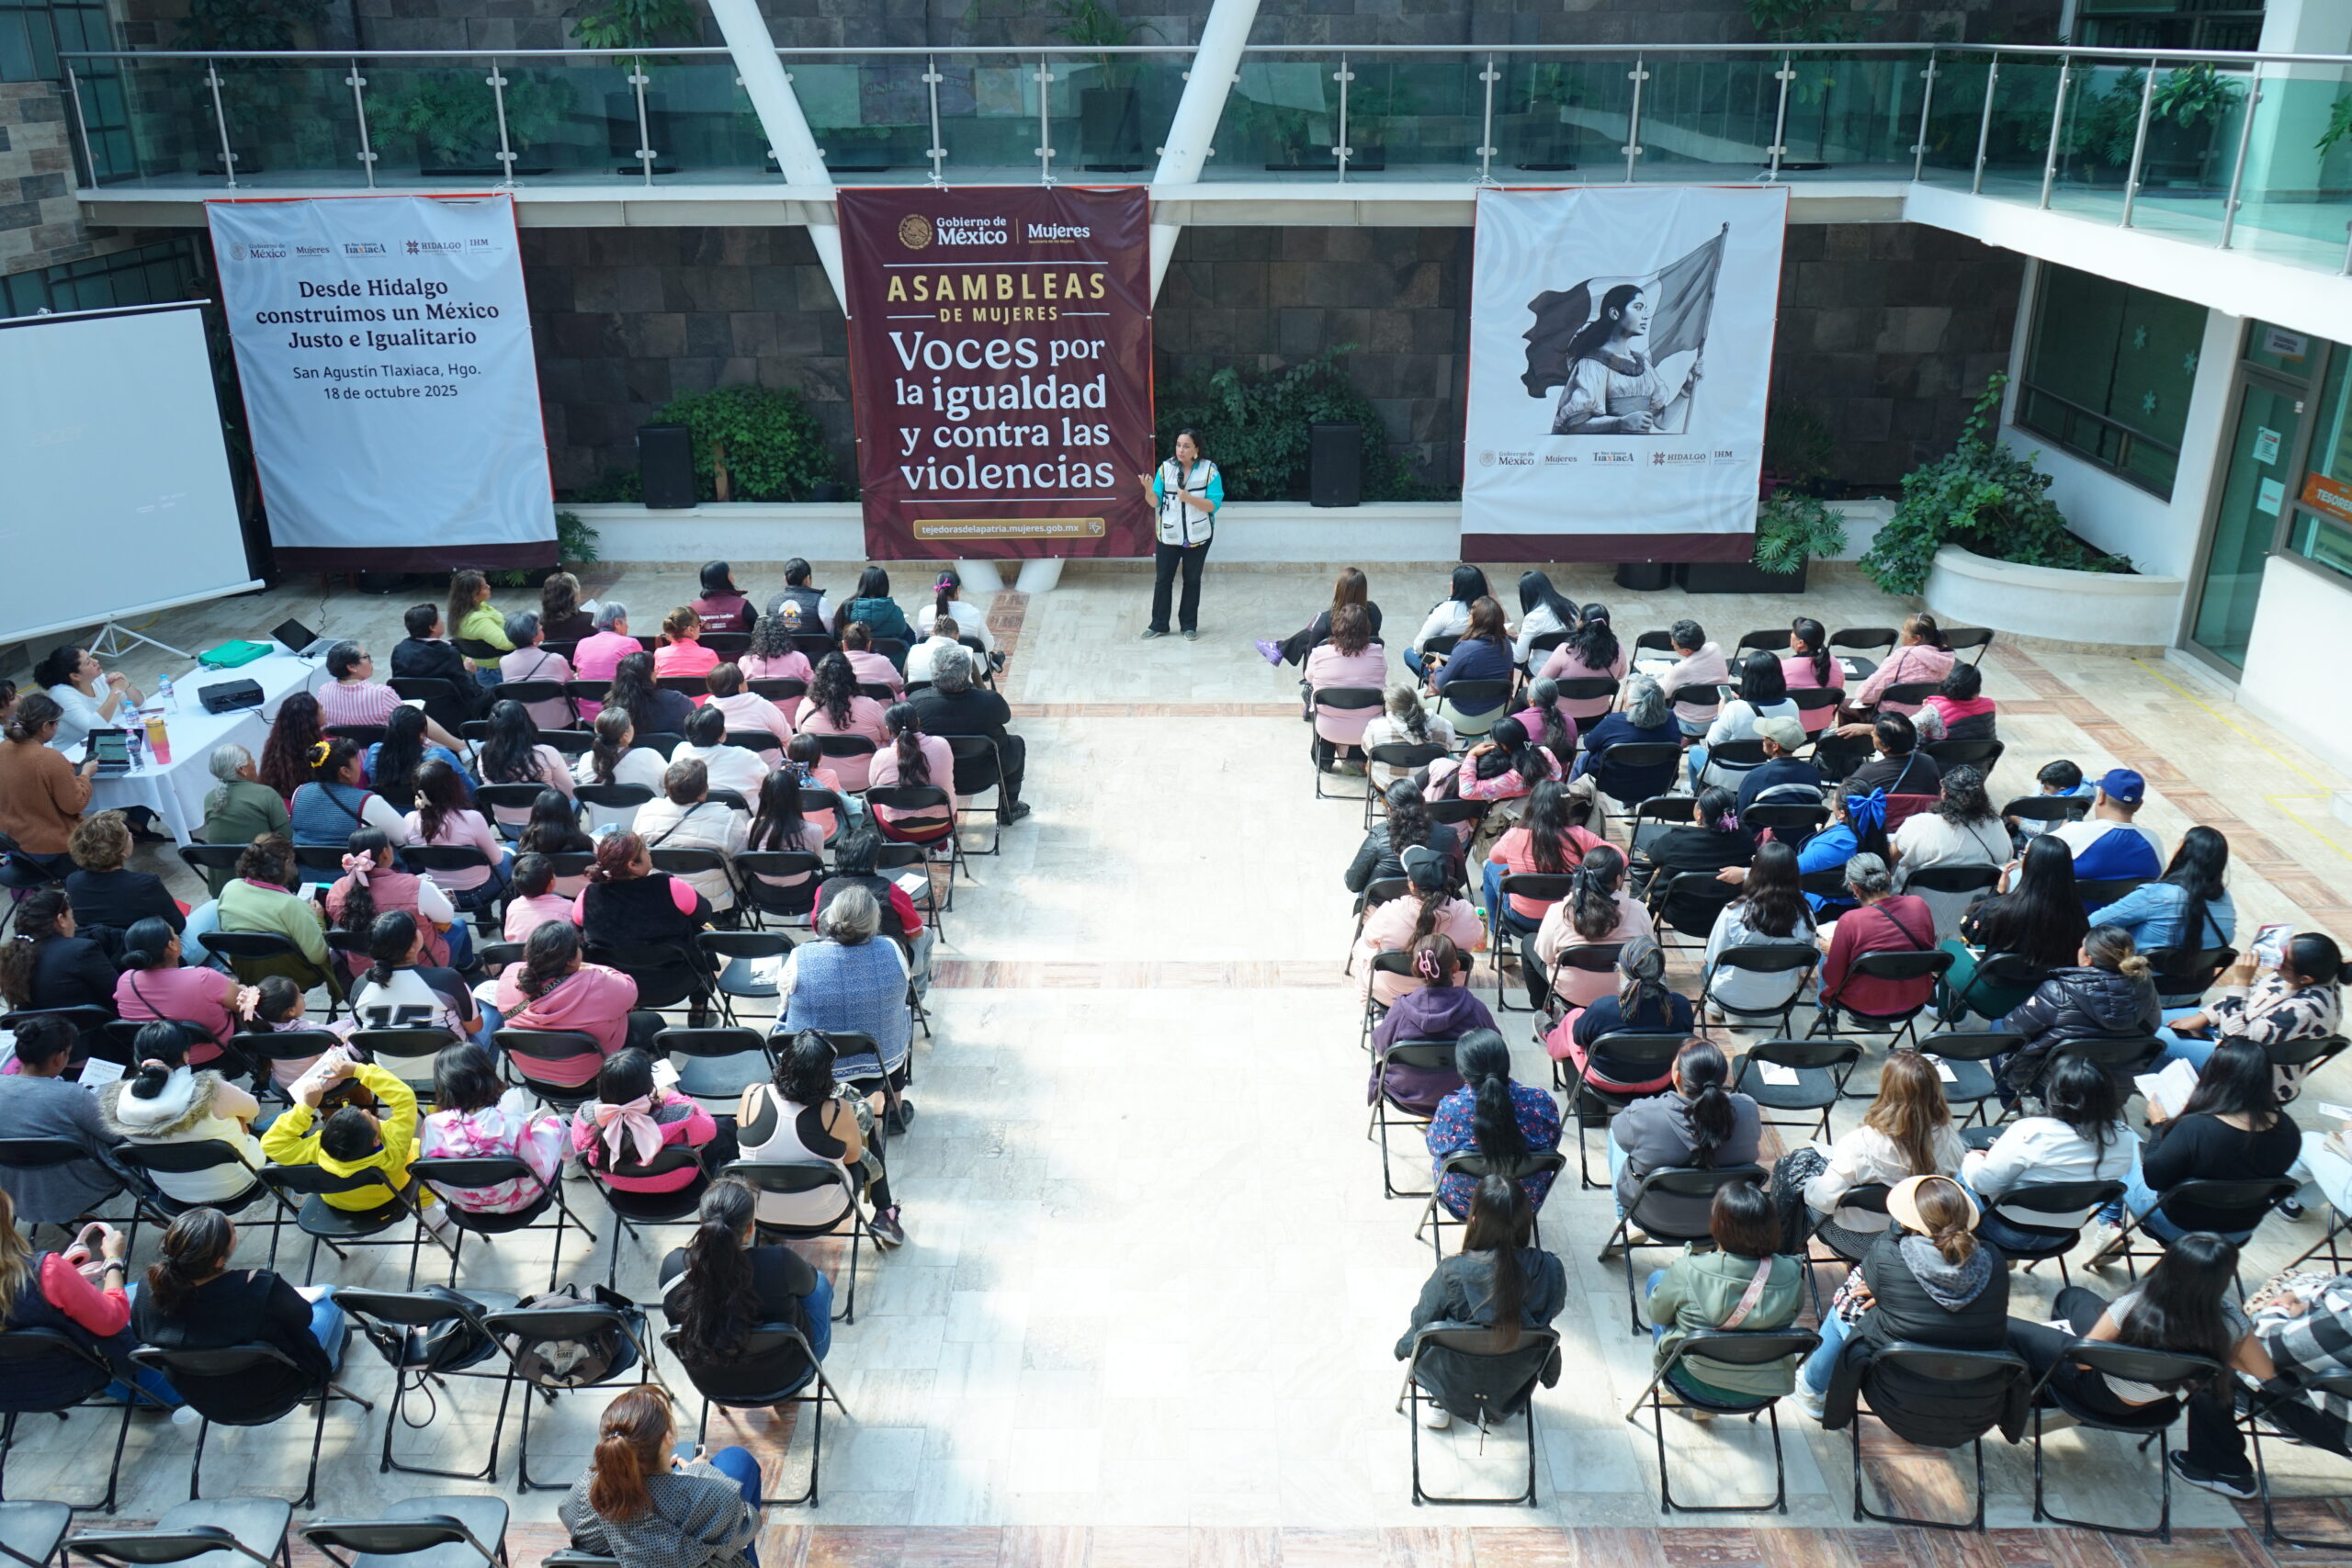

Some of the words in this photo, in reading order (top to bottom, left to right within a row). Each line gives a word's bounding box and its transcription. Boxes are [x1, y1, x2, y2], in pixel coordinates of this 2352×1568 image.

[937, 217, 990, 228] Gobierno
[993, 216, 1006, 226] de
[938, 227, 1007, 244] México
[1028, 224, 1090, 239] Mujeres
[296, 245, 330, 255] Mujeres
[422, 242, 461, 250] HIDALGO
[469, 238, 489, 246] IHM
[250, 249, 287, 259] México
[299, 279, 361, 298] Desde
[368, 278, 447, 299] Hidalgo
[888, 273, 1104, 301] ASAMBLEAS
[256, 306, 386, 324] construimos
[392, 309, 419, 321] un
[426, 302, 499, 320] México
[940, 309, 962, 321] DE
[973, 307, 1057, 324] MUJERES
[288, 333, 343, 348] Justo
[349, 335, 360, 346] e
[367, 328, 476, 351] Igualitario
[889, 332, 1038, 370] Voces
[1050, 340, 1105, 367] por
[293, 367, 319, 378] San
[323, 366, 377, 381] Agustín
[380, 365, 443, 377] Tlaxiaca,
[448, 364, 481, 378] Hgo.
[324, 388, 340, 399] 18
[344, 388, 359, 399] de
[365, 386, 420, 399] octubre
[424, 385, 458, 397] 2025
[896, 378, 923, 404] la
[933, 374, 1105, 423] igualdad
[900, 428, 921, 456] y
[933, 419, 1048, 447] contra
[1062, 417, 1110, 446] las
[1498, 456, 1534, 466] México
[1544, 455, 1577, 463] Mujeres
[1714, 450, 1733, 458] IHM
[900, 454, 1114, 490] violencias
[922, 524, 1079, 535] tejedorasdelapatria.mujeres.gob.mx
[365, 1003, 434, 1029] 15
